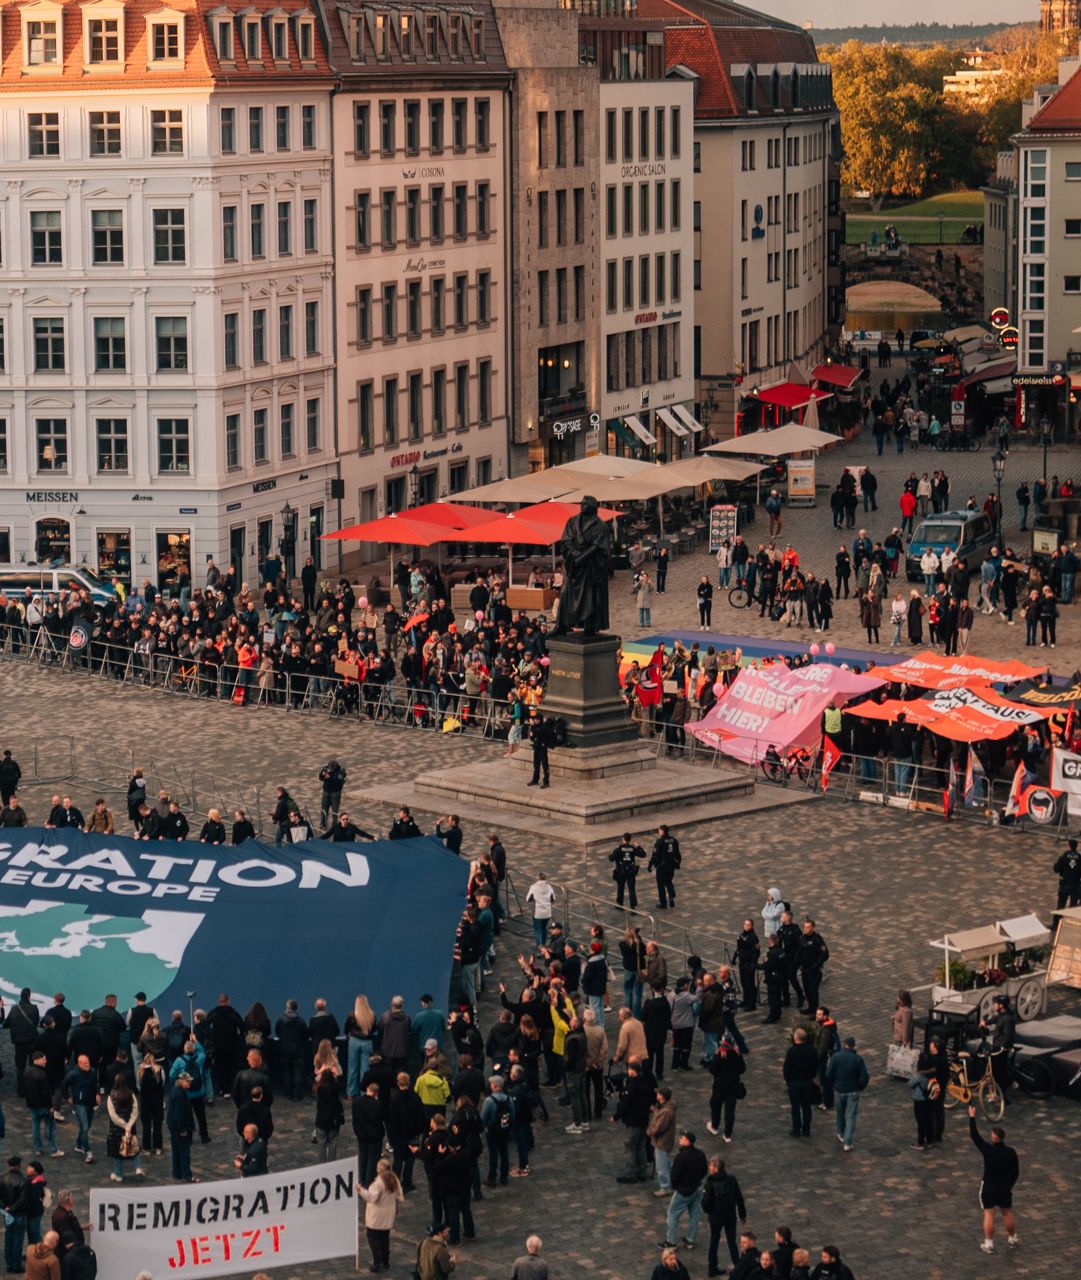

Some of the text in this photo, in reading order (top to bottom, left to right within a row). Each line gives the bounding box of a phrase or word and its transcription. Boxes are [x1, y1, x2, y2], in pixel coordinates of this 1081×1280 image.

[1012, 376, 1052, 385] edelweiss
[390, 451, 420, 469] ONTARIO
[26, 492, 78, 502] MEISSEN
[253, 480, 277, 494] MEISSEN
[731, 681, 803, 714] BLEIBEN
[716, 703, 770, 733] HIER!
[0, 868, 221, 902] EUROPE
[98, 1171, 354, 1232] REMIGRATION
[168, 1225, 286, 1269] JETZT
